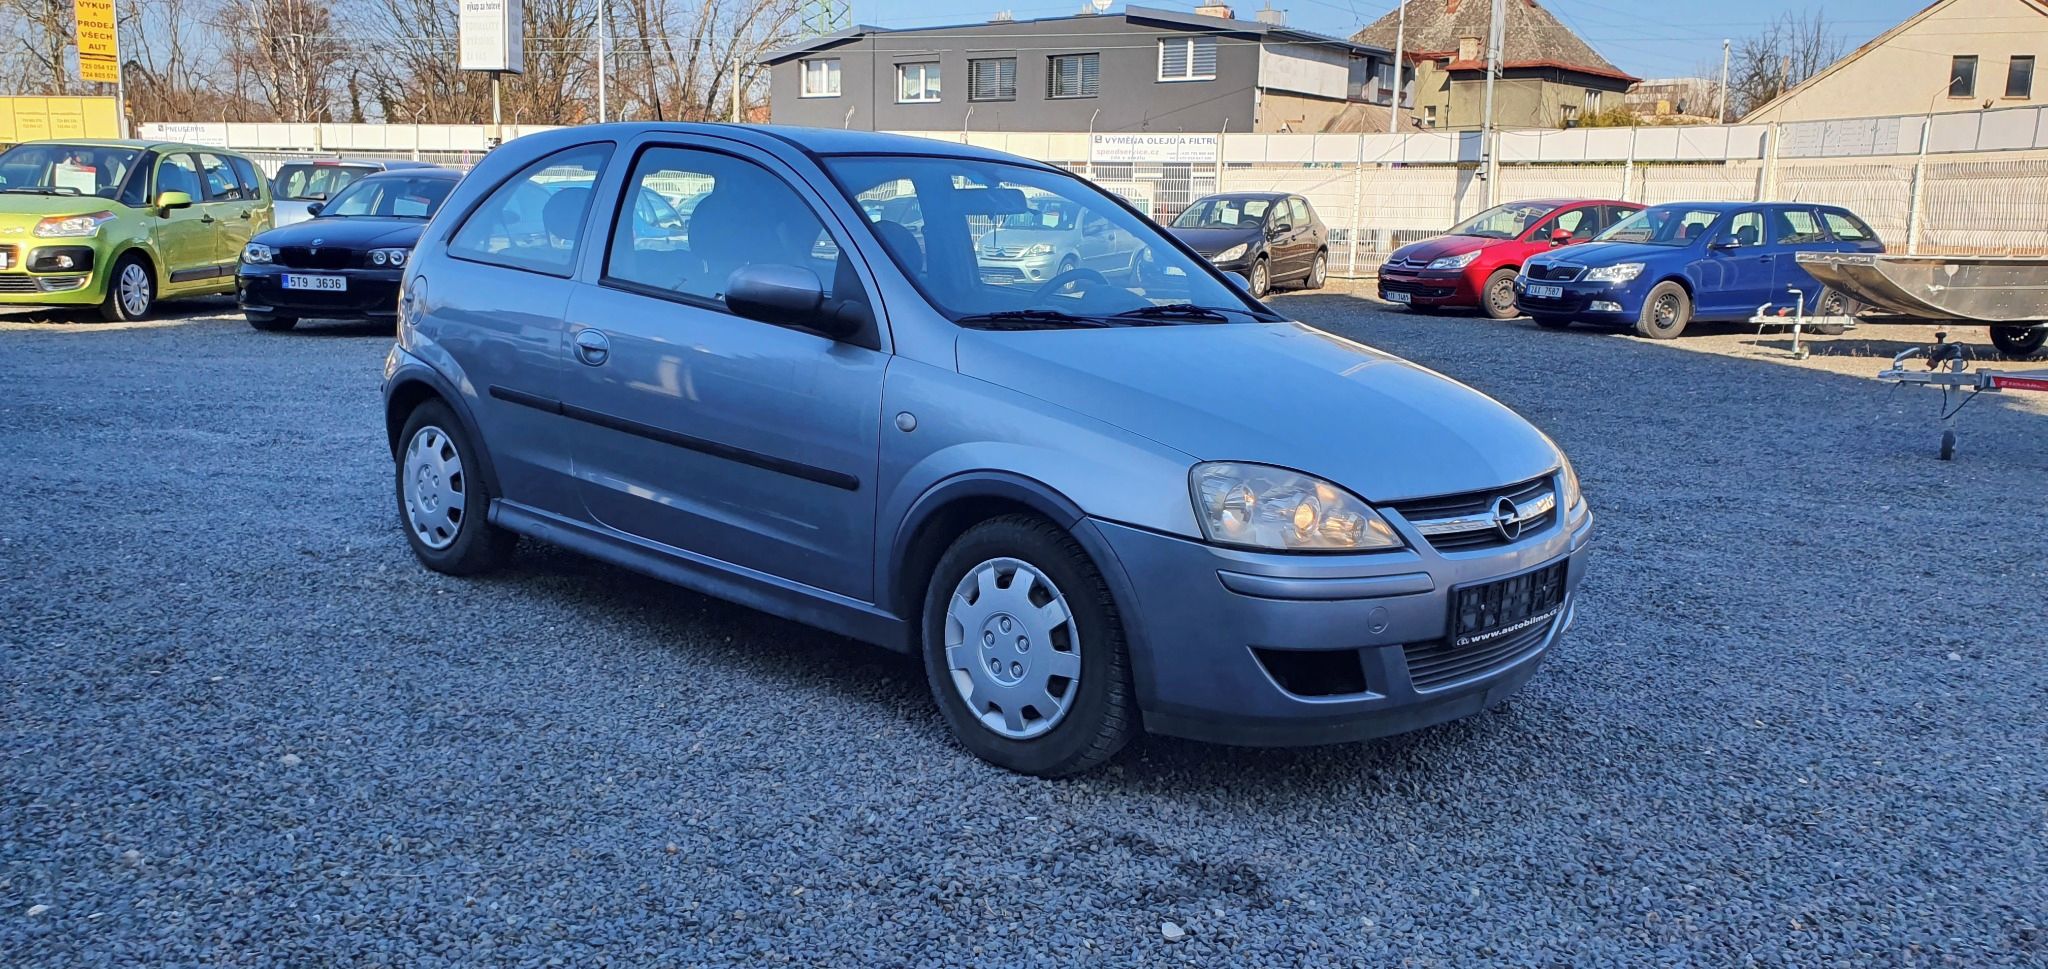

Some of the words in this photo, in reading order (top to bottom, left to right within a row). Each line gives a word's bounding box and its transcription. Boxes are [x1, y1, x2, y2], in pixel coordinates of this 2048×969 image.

[77, 20, 115, 30] PRODEJ
[81, 31, 113, 41] VŠECH
[88, 43, 107, 51] AUT
[165, 125, 206, 133] PNEUSERVIS
[1179, 137, 1187, 145] A
[290, 276, 309, 288] 5T9
[315, 278, 342, 289] 3636
